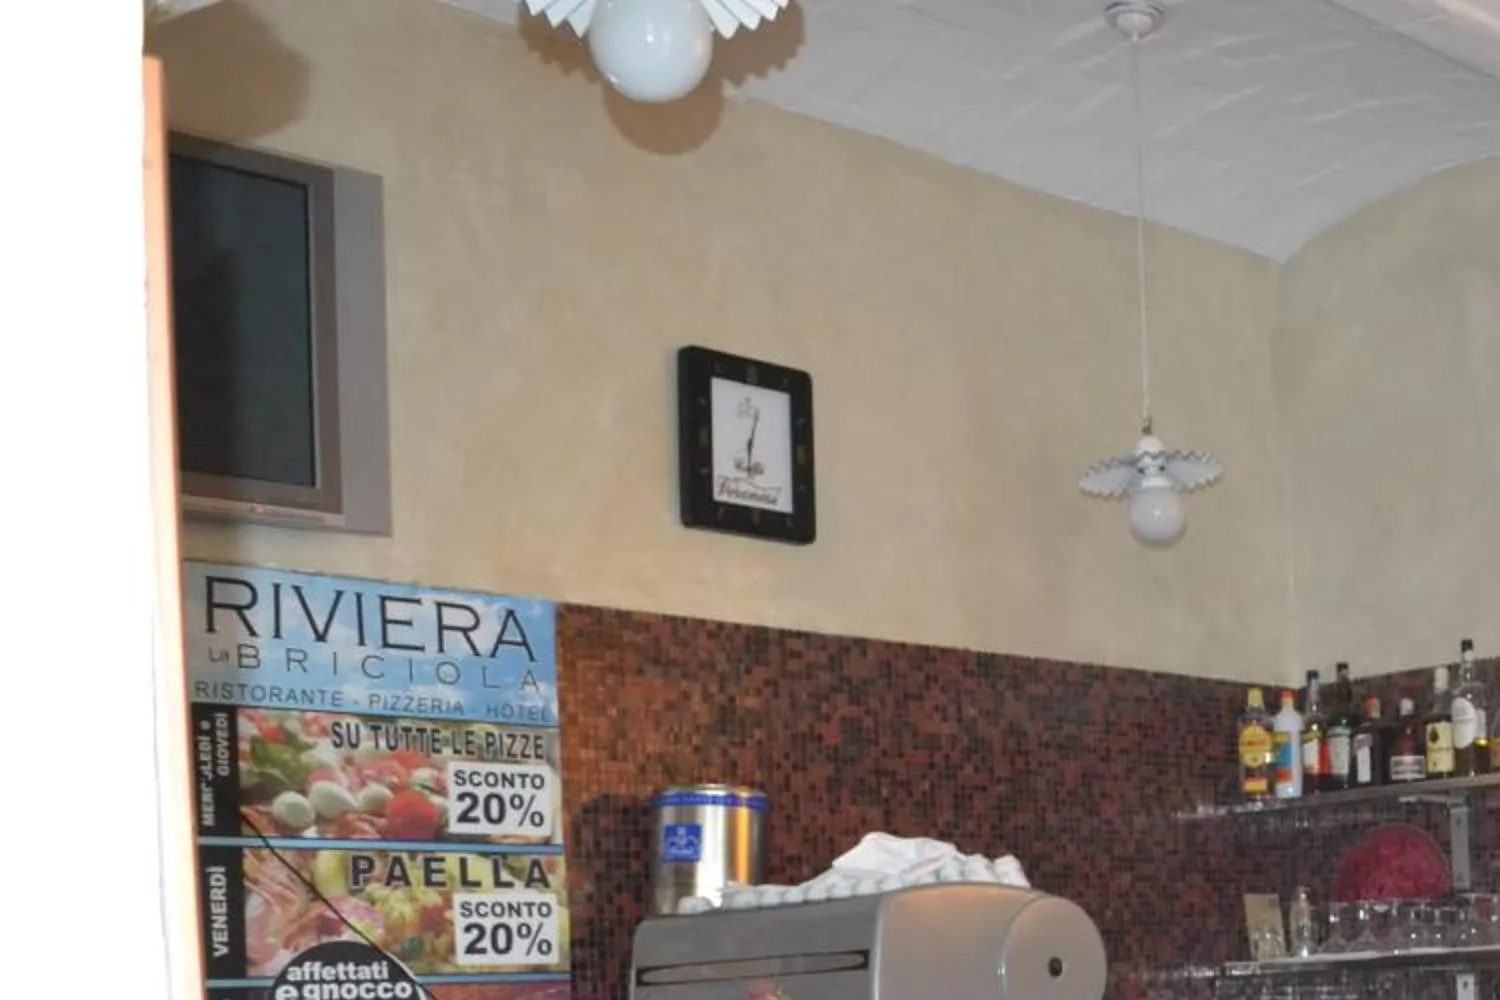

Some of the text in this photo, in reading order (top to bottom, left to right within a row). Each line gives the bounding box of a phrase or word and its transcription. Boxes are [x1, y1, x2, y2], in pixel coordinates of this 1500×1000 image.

[204, 575, 537, 662] RIVIERA
[237, 643, 541, 693] BRICIOLA
[195, 680, 552, 723] RISTORANTE PIZZERIA HOTEL
[331, 721, 545, 759] SU TUTTE LE PIZZE
[454, 769, 545, 790] SCONTO
[456, 792, 545, 827] 20%
[349, 855, 551, 889] PAELLA
[459, 900, 553, 919] SCONTO
[463, 921, 553, 957] 20%
[287, 961, 389, 981] affettati
